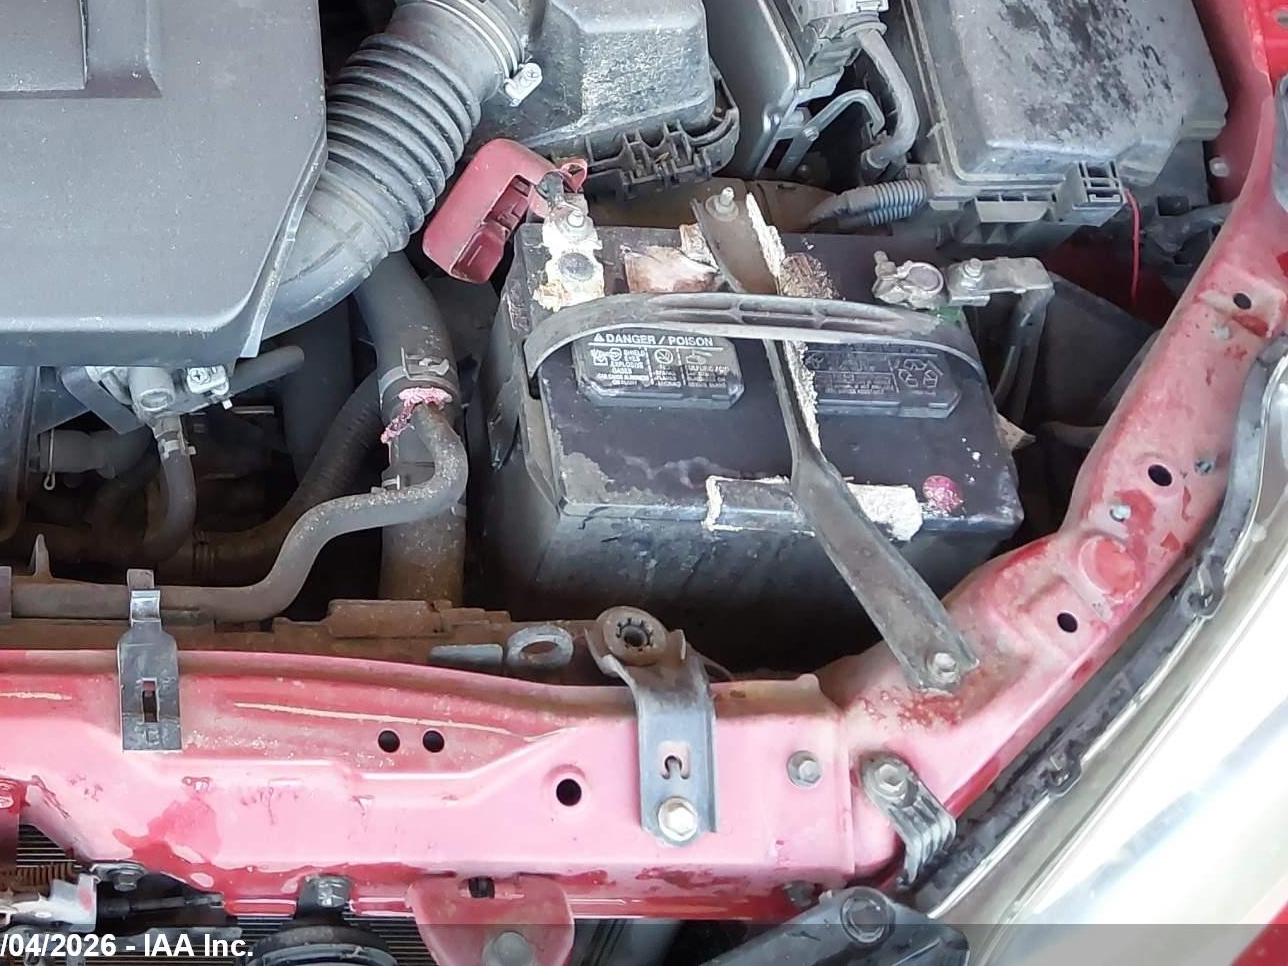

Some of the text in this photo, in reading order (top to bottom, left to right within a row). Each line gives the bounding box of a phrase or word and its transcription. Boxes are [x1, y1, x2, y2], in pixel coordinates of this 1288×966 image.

[605, 333, 714, 347] DANGER / POISON
